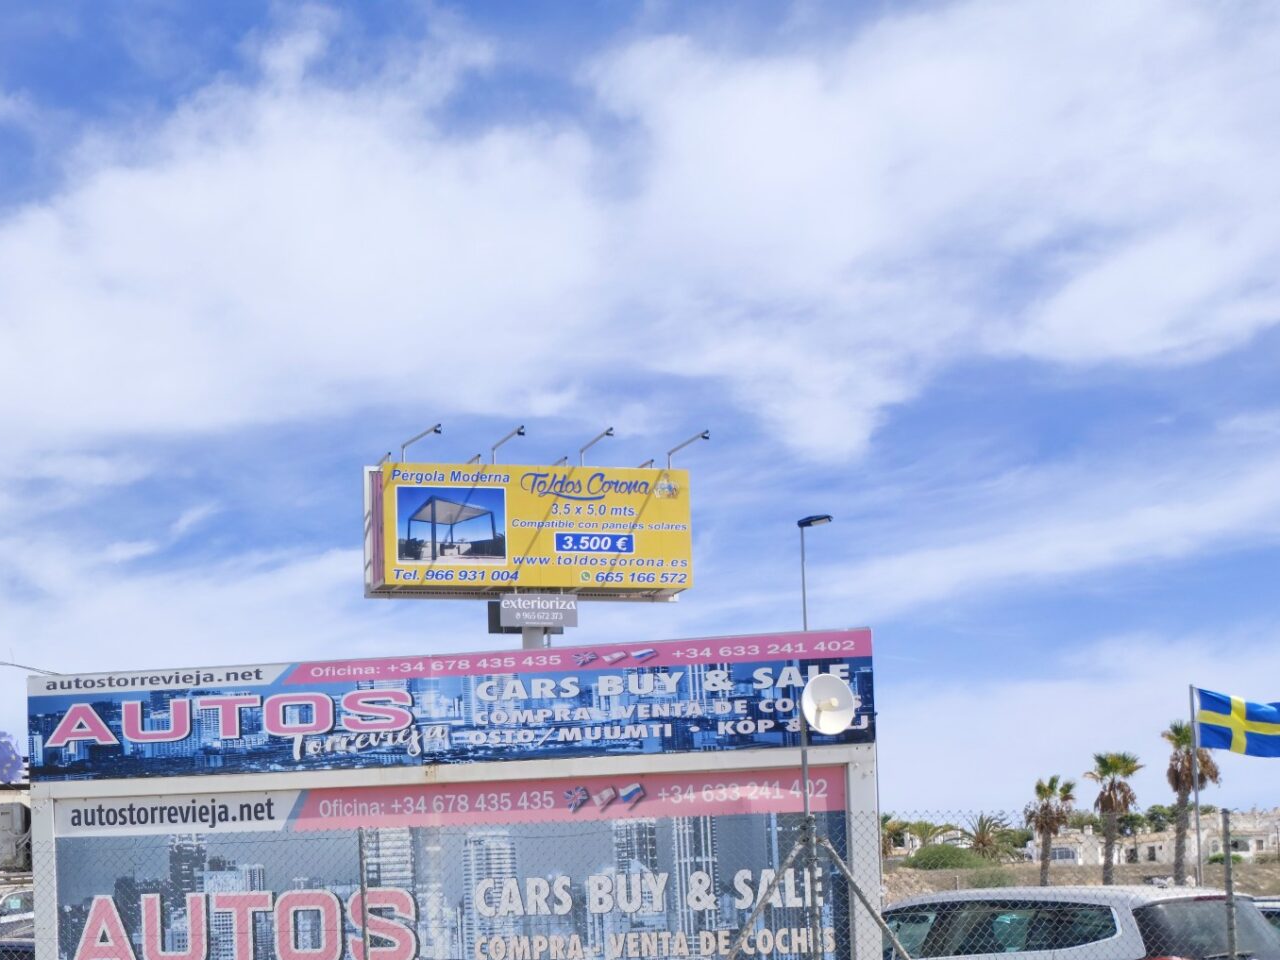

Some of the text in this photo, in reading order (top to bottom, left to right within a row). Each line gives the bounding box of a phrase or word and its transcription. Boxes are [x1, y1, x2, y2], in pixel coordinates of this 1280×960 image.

[450, 470, 510, 483] Moderna
[520, 472, 651, 500] Toldos Corona
[511, 518, 575, 529] Compatible
[602, 521, 644, 531] paneles
[647, 522, 688, 531] solares
[562, 536, 629, 551] 3.500 €
[513, 554, 688, 568] www.toldoscorona.es
[393, 568, 519, 581] Tel. 966 931 004
[595, 572, 688, 584] 665 166 572
[501, 597, 577, 610] exterioriza
[671, 640, 856, 659] +34 633 241 402
[310, 655, 562, 678] Oficina: +34 678 435 435
[46, 667, 263, 692] autostorrevieja.net
[476, 677, 580, 701] CARS
[598, 671, 685, 696] BUY
[703, 669, 735, 691] &
[44, 689, 415, 749] AUTOS
[475, 707, 591, 725] COMPRA
[618, 702, 705, 719] VENTA
[713, 699, 748, 715] DE
[758, 694, 863, 713] COS
[469, 723, 672, 747] OSTO/MUUMTI
[717, 716, 775, 735] KÖP
[657, 785, 696, 803] +34
[702, 783, 741, 802] 633
[747, 780, 784, 800] 241
[70, 799, 276, 828] autostorrevieja.net
[318, 790, 555, 818] Oficina: +34 678 435 435
[475, 867, 824, 917] CARS BUY & SALE
[610, 931, 691, 958] VENTA
[700, 930, 731, 955] DE
